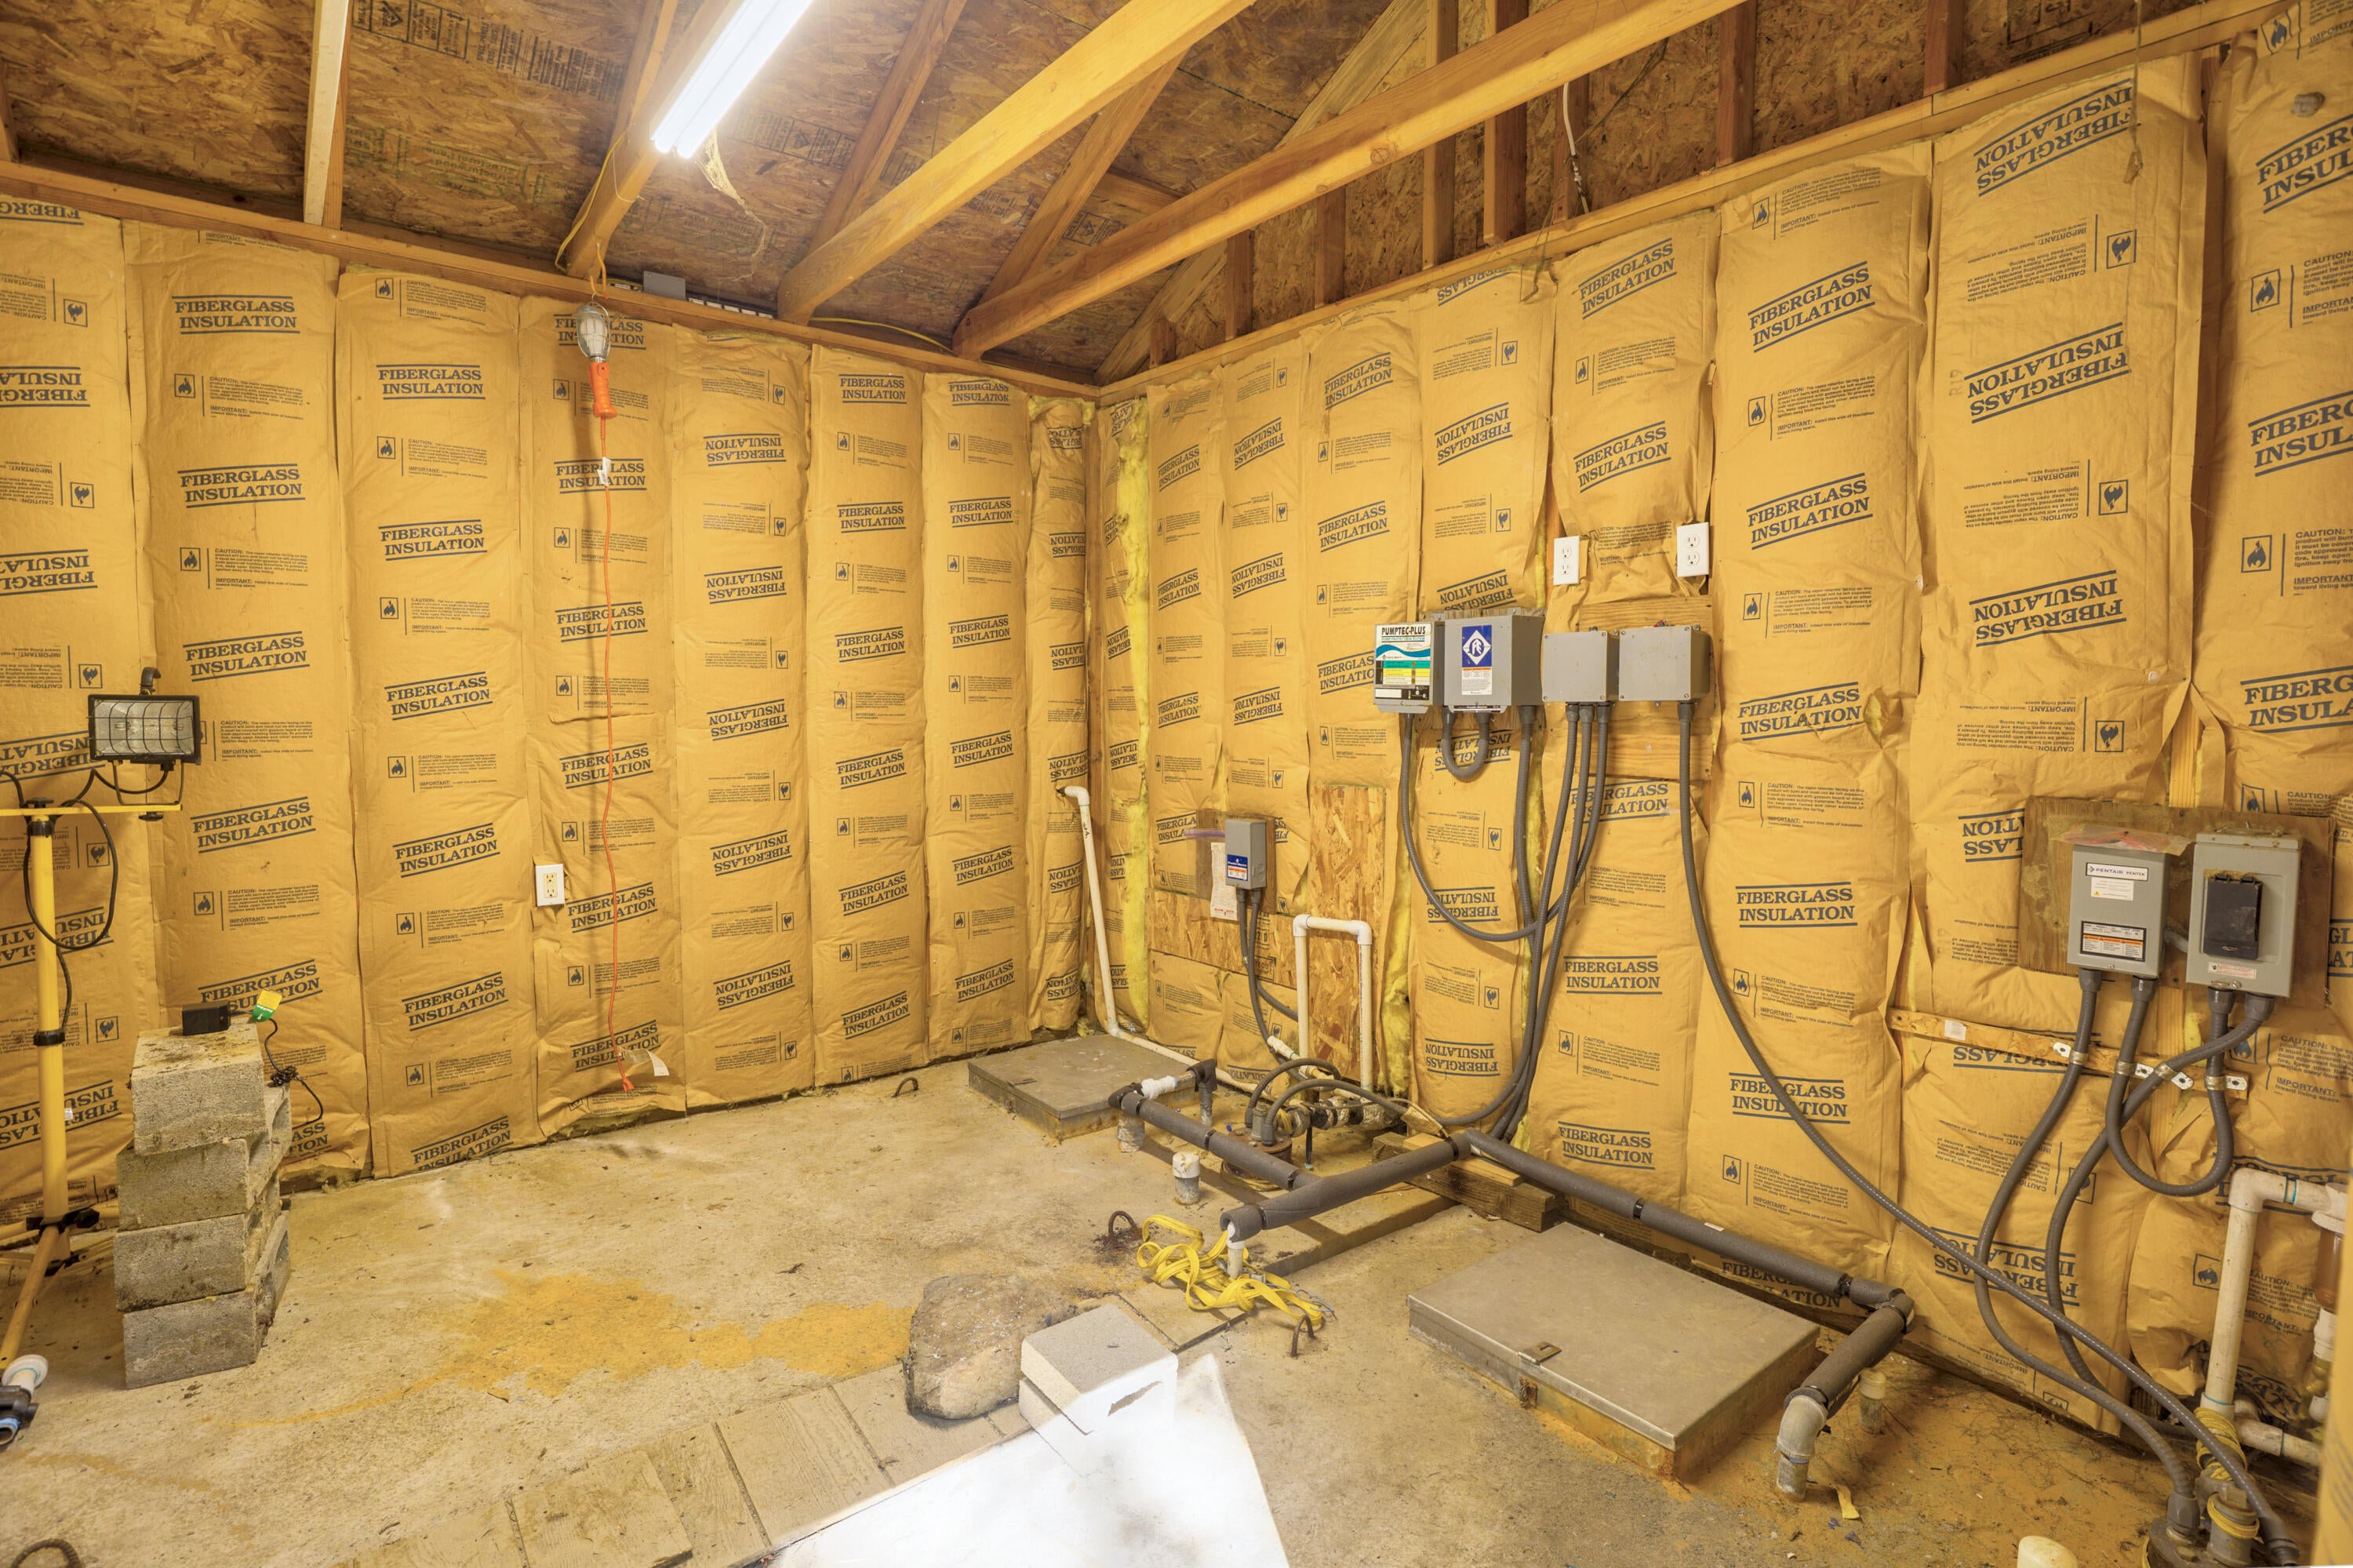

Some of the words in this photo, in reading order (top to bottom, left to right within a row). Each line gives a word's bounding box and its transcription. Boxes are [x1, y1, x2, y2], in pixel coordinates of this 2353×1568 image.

[1781, 182, 1809, 196] CAUTION:
[2038, 227, 2086, 246] IMPORTANT:
[1580, 243, 1673, 300] FIBERGLASS
[2048, 270, 2086, 283] CAUTION:
[1582, 257, 1675, 314] INSULATION
[175, 300, 295, 314] FIBERGLASS
[1750, 267, 1870, 330] FIBERGLASS
[180, 315, 296, 329] INSULATION
[1753, 284, 1872, 347] INSULATION
[379, 369, 482, 380] FIBERGLASS
[1967, 329, 2124, 398] INSULATION
[840, 378, 905, 388] FIBERGLASS
[1325, 357, 1391, 394] FIBERGLASS
[1969, 351, 2128, 417] FIBERGLASS
[383, 383, 483, 395] INSULATION
[842, 389, 905, 399] INSULATION
[949, 381, 1010, 394] FIBERGLASS
[951, 392, 1009, 402] INSULATION
[1326, 369, 1392, 406] INSULATION
[1777, 386, 1805, 397] CAUTION:
[1235, 422, 1282, 455] INSULATION
[1436, 408, 1508, 446] INSULATION
[705, 437, 781, 450] INSULATION
[1234, 433, 1283, 465] FIBERGLASS
[1437, 422, 1511, 460] FIBERGLASS
[1575, 427, 1667, 473] FIBERGLASS
[707, 449, 784, 461] FIBERGLASS
[1158, 450, 1199, 475] FIBERGLASS
[1578, 442, 1668, 487] INSULATION
[180, 468, 300, 488] FIBERGLASS
[1159, 460, 1199, 487] INSULATION
[2030, 471, 2079, 482] IMPORTANT:
[185, 483, 302, 503] INSULATION
[1748, 479, 1867, 527] FIBERGLASS
[838, 505, 904, 518] FIBERGLASS
[950, 500, 1012, 513] FIBERGLASS
[952, 511, 1012, 524] INSULATION
[2040, 512, 2078, 521] CAUTION:
[841, 516, 904, 529] INSULATION
[1318, 506, 1387, 536] FIBERGLASS
[1751, 497, 1870, 544] INSULATION
[381, 524, 483, 542] FIBERGLASS
[1320, 518, 1387, 548] INSULATION
[2296, 529, 2345, 538] CAUTION:
[385, 537, 485, 556] INSULATION
[707, 570, 783, 588] INSULATION
[1231, 557, 1283, 583] INSULATION
[1232, 568, 1285, 595] FIBERGLASS
[707, 582, 785, 599] FIBERGLASS
[1158, 573, 1198, 595] FIBERGLASS
[1158, 584, 1199, 606] INSULATION
[1439, 574, 1509, 605] INSULATION
[1775, 589, 1803, 598] CAUTION:
[1974, 578, 2118, 623] INSULATION
[950, 617, 1009, 634] FIBERGLASS
[1381, 626, 1426, 635] PUMPTEC-PLUS
[1976, 598, 2123, 640] FIBERGLASS
[836, 630, 904, 647] FIBERGLASS
[952, 628, 1010, 645] INSULATION
[186, 636, 304, 661] FIBERGLASS
[838, 641, 905, 658] INSULATION
[191, 650, 307, 676] INSULATION
[387, 676, 489, 702] FIBERGLASS
[391, 689, 489, 715] INSULATION
[1158, 696, 1198, 714] FIBERGLASS
[1235, 691, 1280, 711] INSULATION
[1235, 702, 1282, 721] FIBERGLASS
[1737, 689, 1860, 719] FIBERGLASS
[709, 703, 785, 726] INSULATION
[711, 714, 787, 737] FIBERGLASS
[1160, 707, 1198, 722] INSULATION
[1740, 706, 1862, 735] INSULATION
[951, 733, 1013, 754] FIBERGLASS
[954, 743, 1013, 765] INSULATION
[838, 752, 904, 775] FIBERGLASS
[840, 762, 905, 785] INSULATION
[193, 802, 311, 834] FIBERGLASS
[198, 815, 313, 848] INSULATION
[395, 827, 495, 860] FIBERGLASS
[712, 834, 788, 860] INSULATION
[399, 839, 497, 873] INSULATION
[714, 845, 791, 872] FIBERGLASS
[954, 849, 1013, 871] FIBERGLASS
[956, 857, 1013, 882] INSULATION
[840, 874, 907, 901] FIBERGLASS
[843, 884, 907, 912] INSULATION
[1737, 888, 1853, 904] FIBERGLASS
[1739, 905, 1855, 922] INSULATION
[956, 962, 1014, 989] FIBERGLASS
[1564, 961, 1659, 973] FIBERGLASS
[201, 964, 318, 1003] FIBERGLASS
[715, 964, 791, 995] INSULATION
[717, 974, 794, 1006] FIBERGLASS
[958, 971, 1014, 999] INSULATION
[1567, 976, 1660, 989] INSULATION
[1761, 975, 1791, 985] CAUTION:
[405, 976, 504, 1014] FIBERGLASS
[409, 988, 505, 1027] INSULATION
[842, 994, 907, 1026] FIBERGLASS
[845, 1004, 909, 1035] INSULATION
[1425, 1044, 1494, 1059] INSULATION
[2281, 1035, 2329, 1050] CAUTION:
[1426, 1057, 1497, 1072] FIBERGLASS
[2277, 1077, 2336, 1097] IMPORTANT:
[413, 1119, 509, 1164] FIBERGLASS
[1558, 1126, 1652, 1148] FIBERGLASS
[1562, 1141, 1653, 1164] INSULATION
[1753, 1164, 1782, 1176] CAUTION:
